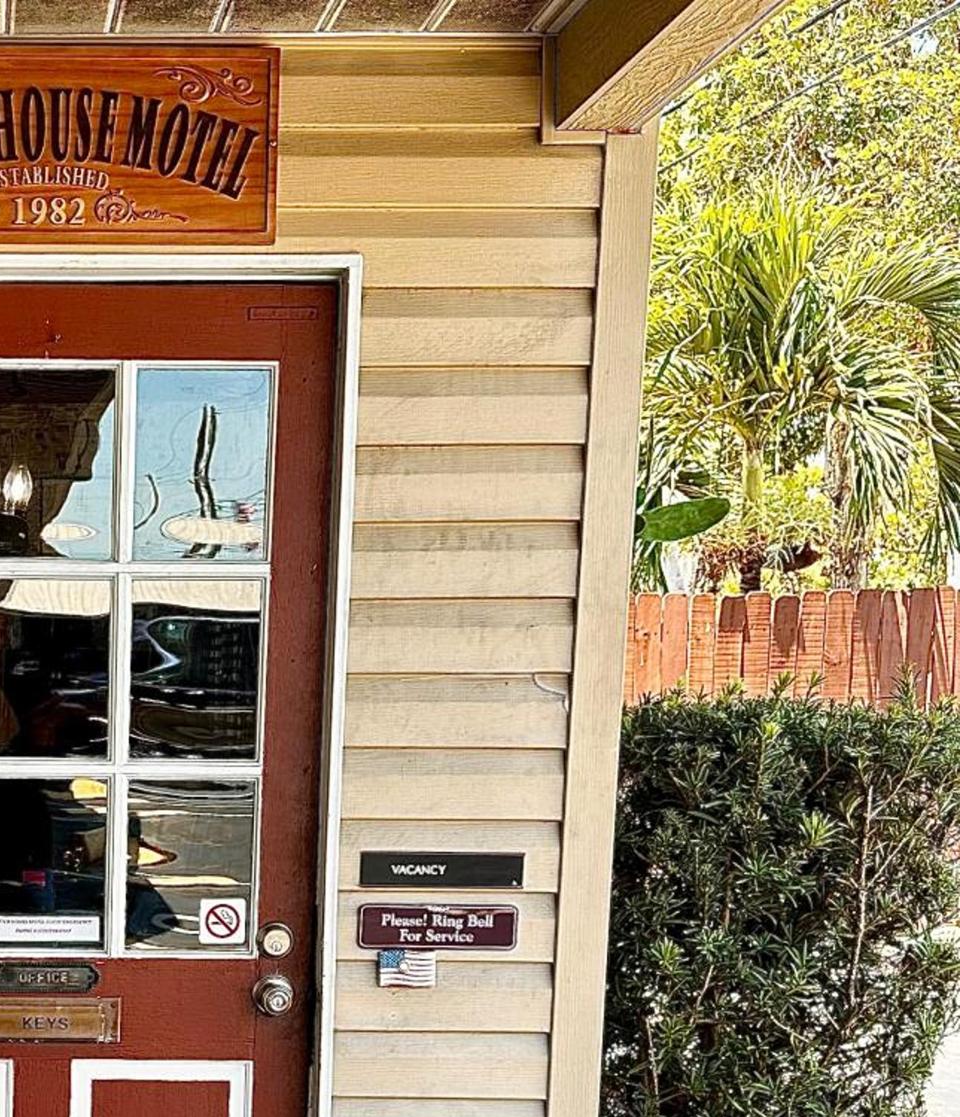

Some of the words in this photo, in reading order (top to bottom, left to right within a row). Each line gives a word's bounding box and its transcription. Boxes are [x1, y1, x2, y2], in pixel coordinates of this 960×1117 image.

[119, 95, 260, 201] MOTEL
[11, 197, 86, 225] 1982
[390, 864, 447, 875] VACANCY
[381, 913, 427, 927] Please!
[432, 914, 464, 930] Ring
[467, 914, 494, 928] Bell
[399, 929, 422, 942] For
[425, 929, 474, 943] Service
[19, 971, 69, 984] OFFICE
[22, 1016, 69, 1030] KEYS
